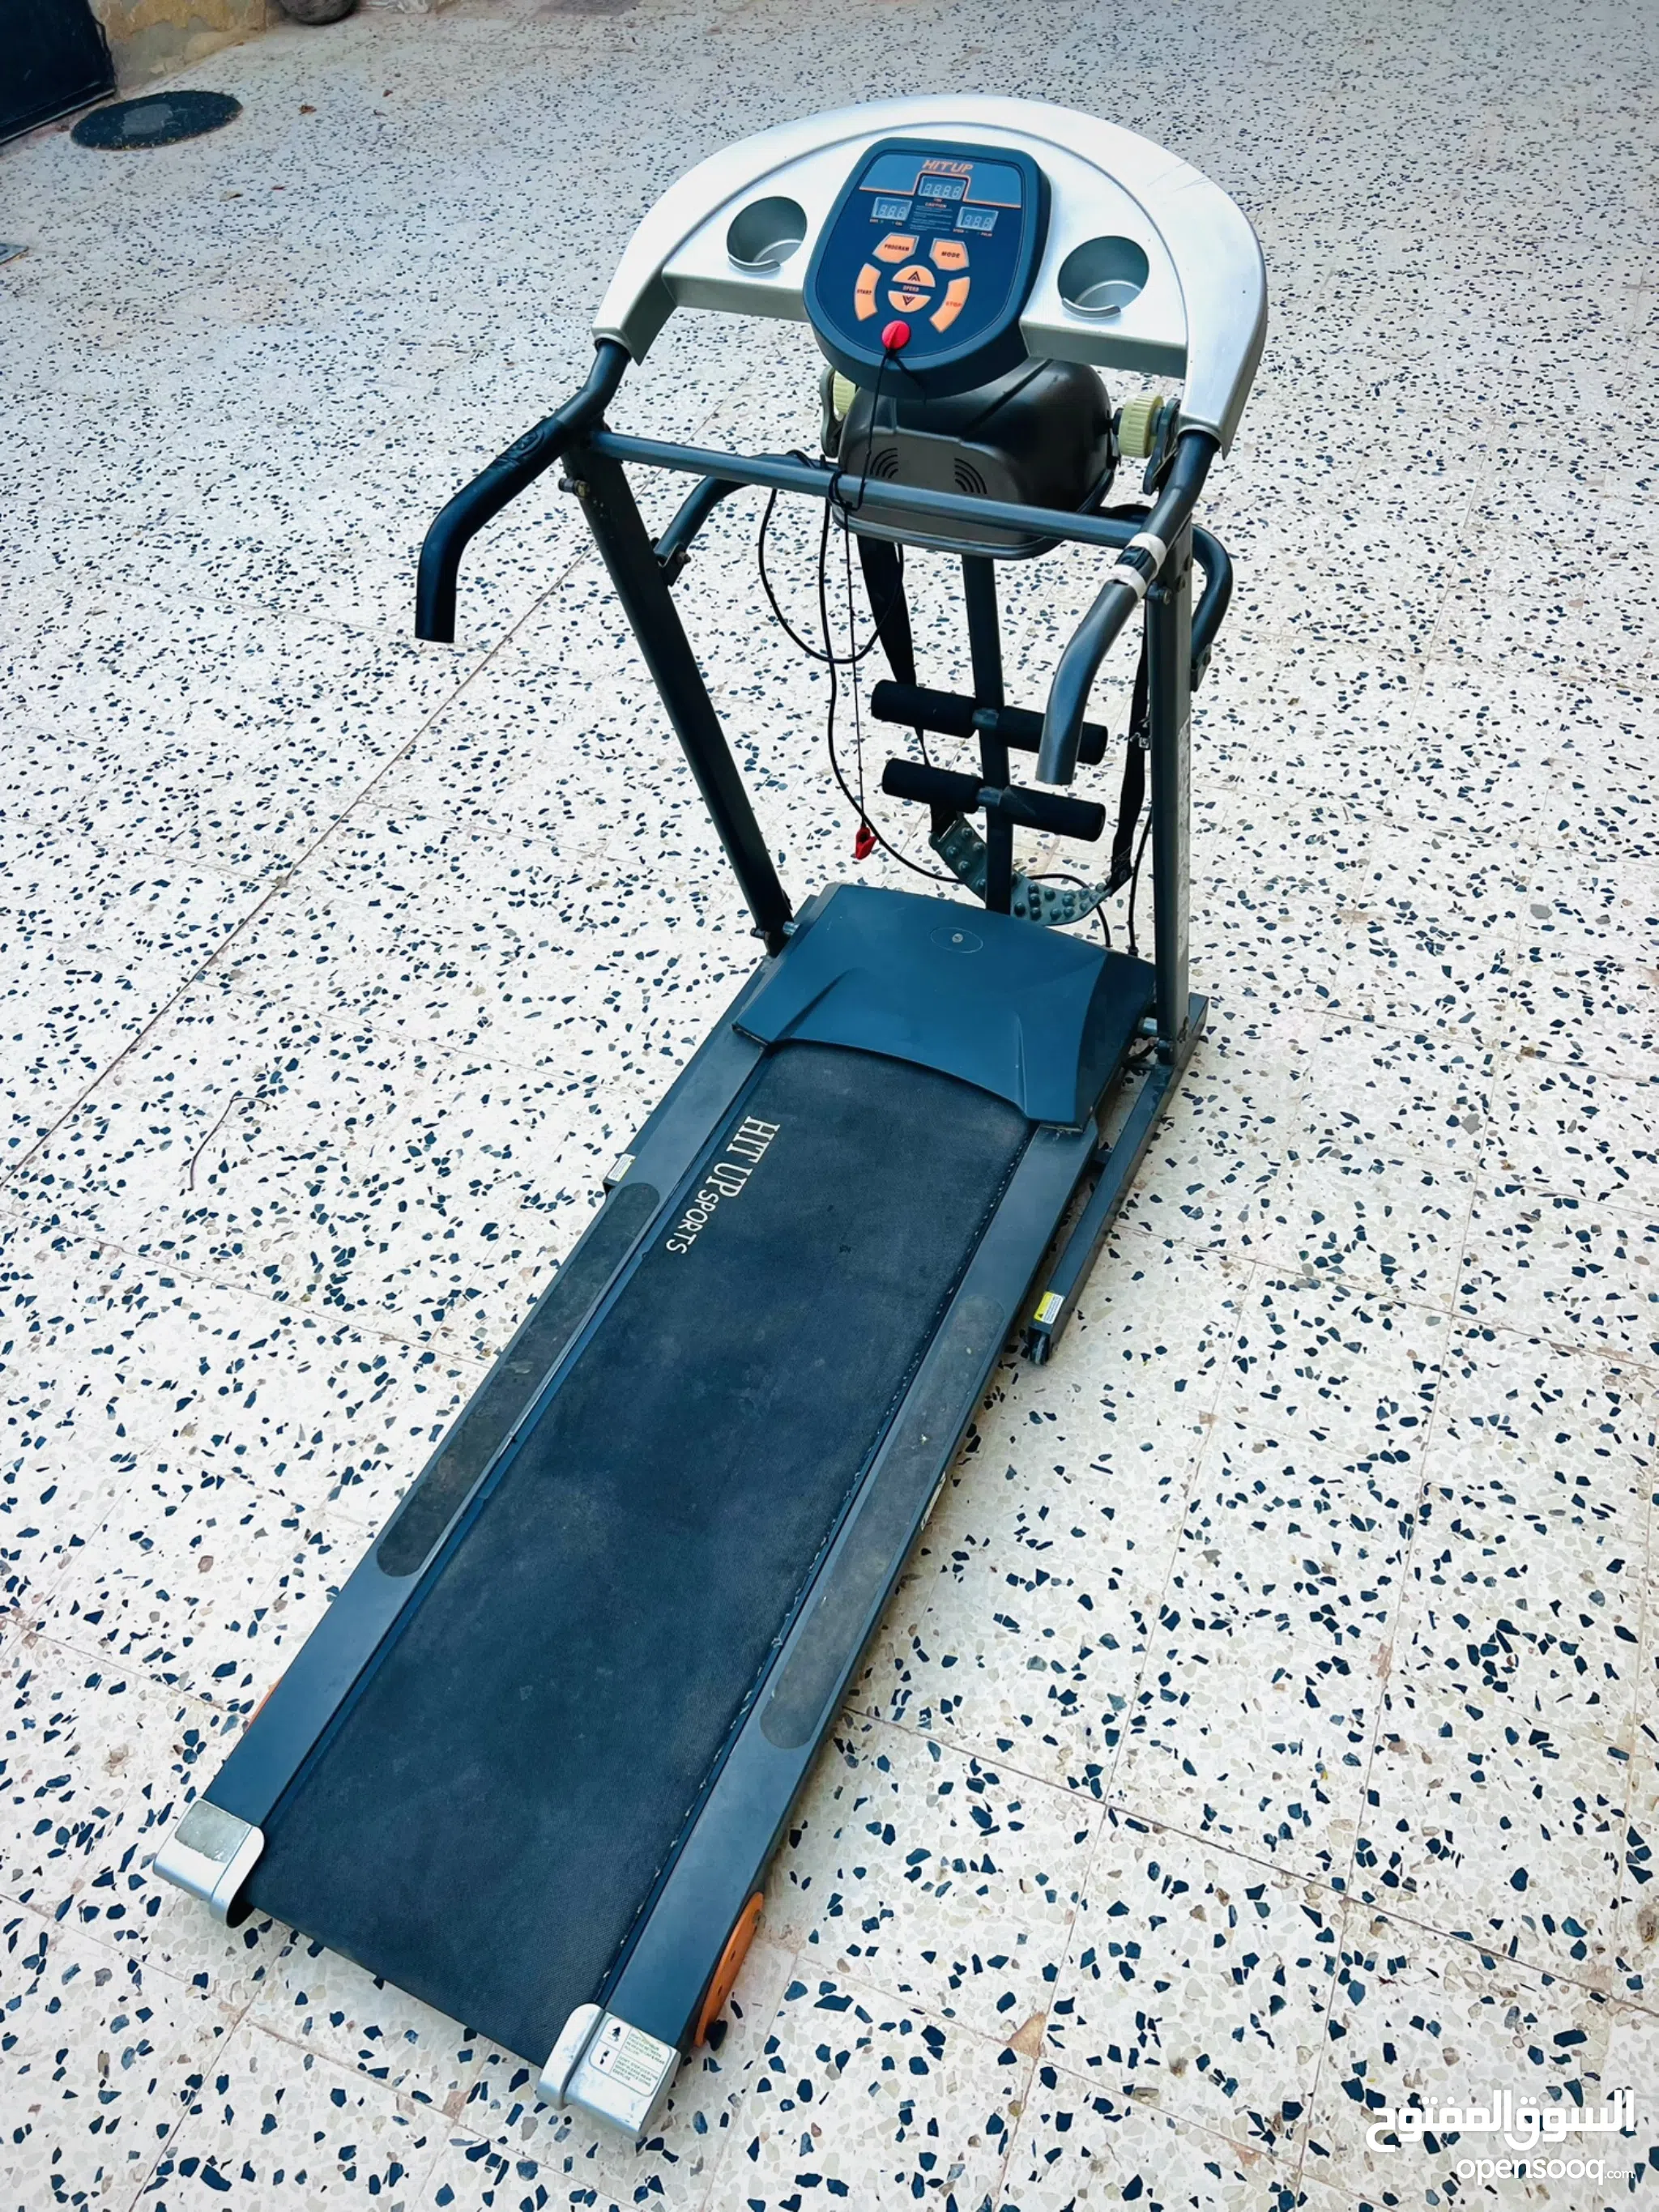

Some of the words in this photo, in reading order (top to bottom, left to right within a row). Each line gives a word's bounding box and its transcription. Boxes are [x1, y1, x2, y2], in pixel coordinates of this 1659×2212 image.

[884, 244, 910, 252] PROGRAM
[726, 1115, 781, 1164] HIT
[706, 1161, 753, 1198] UP
[665, 1189, 719, 1255] SPORTS
